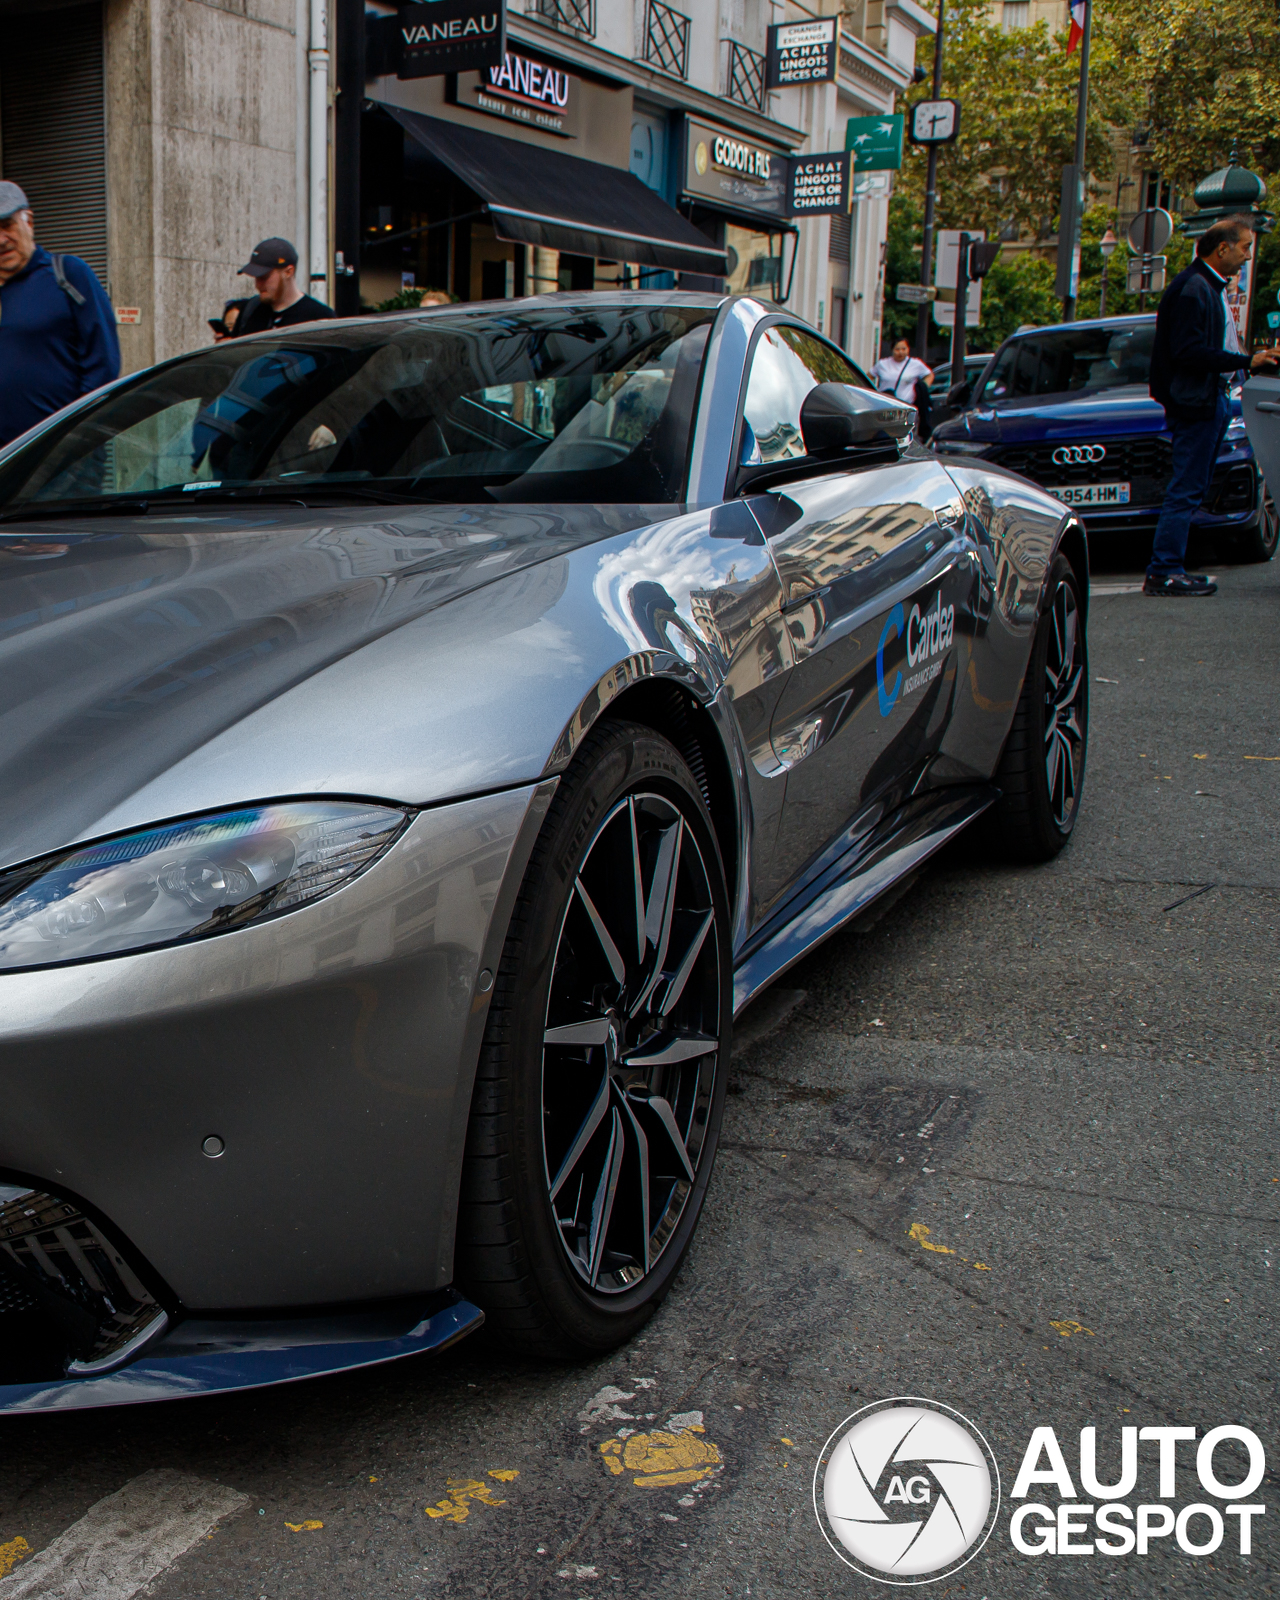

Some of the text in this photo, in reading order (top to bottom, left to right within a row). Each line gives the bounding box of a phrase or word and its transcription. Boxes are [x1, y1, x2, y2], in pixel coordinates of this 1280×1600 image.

[402, 14, 498, 45] VANEAU
[788, 24, 823, 35] CHANGE
[783, 32, 827, 45] EXCHANGE
[780, 43, 829, 60] ACHAT
[779, 55, 829, 72] LINGOTS
[489, 52, 569, 107] VANEAU
[812, 66, 829, 79] OR
[478, 92, 563, 130] luxury real estate
[714, 136, 749, 173] GODOT
[755, 150, 771, 180] FILS
[794, 161, 843, 176] ACHAT
[794, 172, 842, 187] LINGOTS
[826, 183, 842, 195] OR
[793, 195, 841, 209] CHANGE
[906, 589, 955, 668] Cardea
[902, 666, 931, 697] INSURANCE
